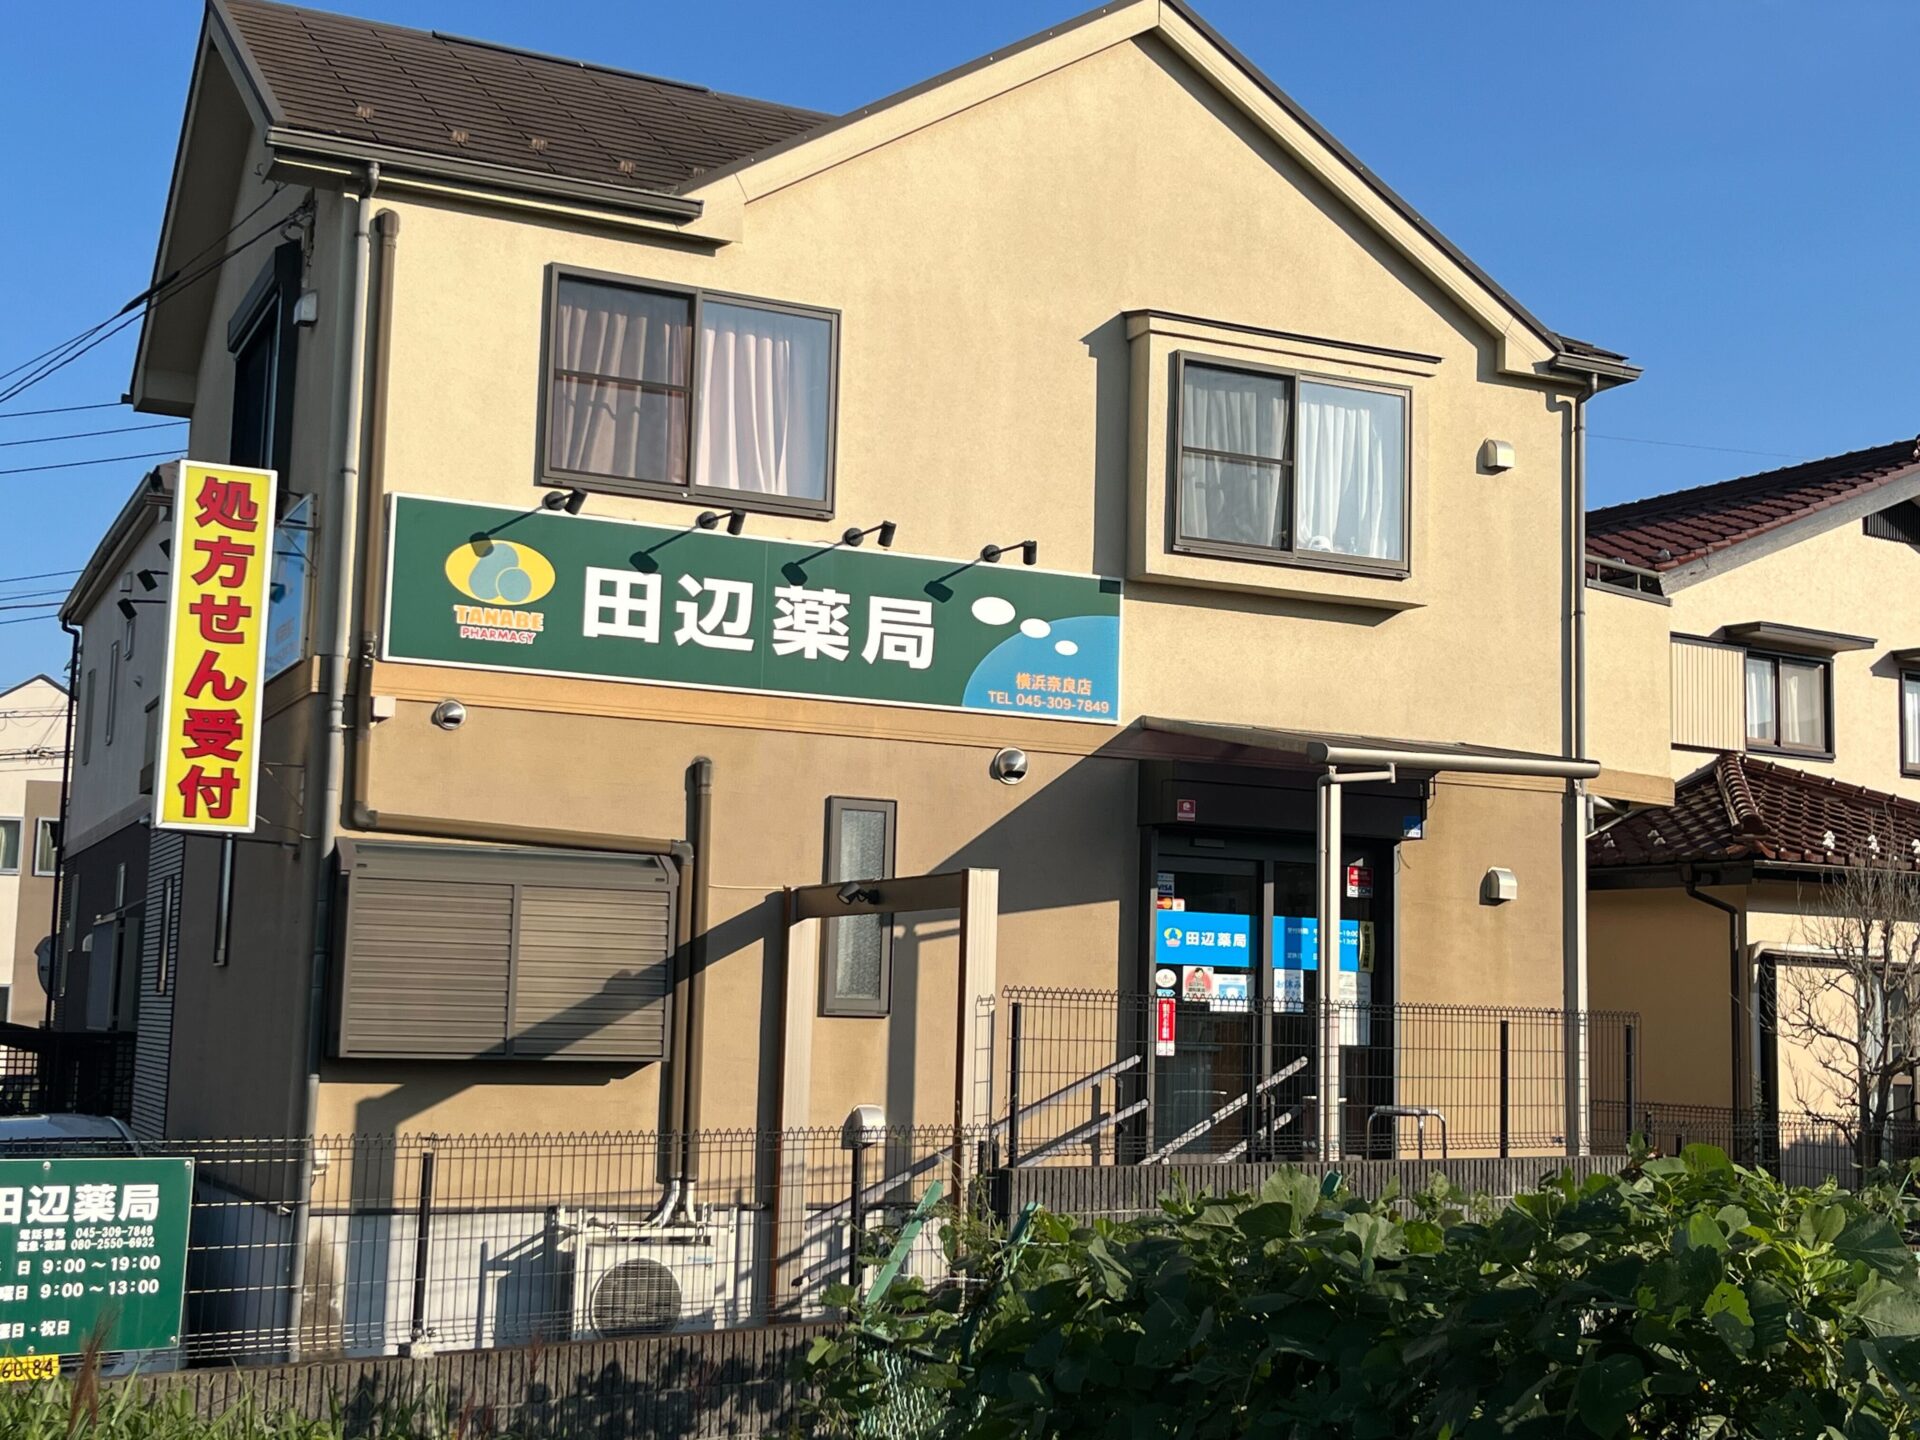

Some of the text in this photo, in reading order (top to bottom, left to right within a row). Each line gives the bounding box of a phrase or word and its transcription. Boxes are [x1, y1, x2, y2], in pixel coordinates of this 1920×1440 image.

[453, 604, 545, 632] TANABE
[583, 565, 935, 671] 田辺薬局
[460, 625, 537, 645] PHARMACY
[178, 475, 258, 820] 処方せん受付
[1015, 672, 1093, 696] 横浜奈良店
[987, 690, 1110, 714] TEL 045-309-7849
[1185, 931, 1247, 948] 田辺薬局
[75, 1225, 154, 1239] 045-309-7849
